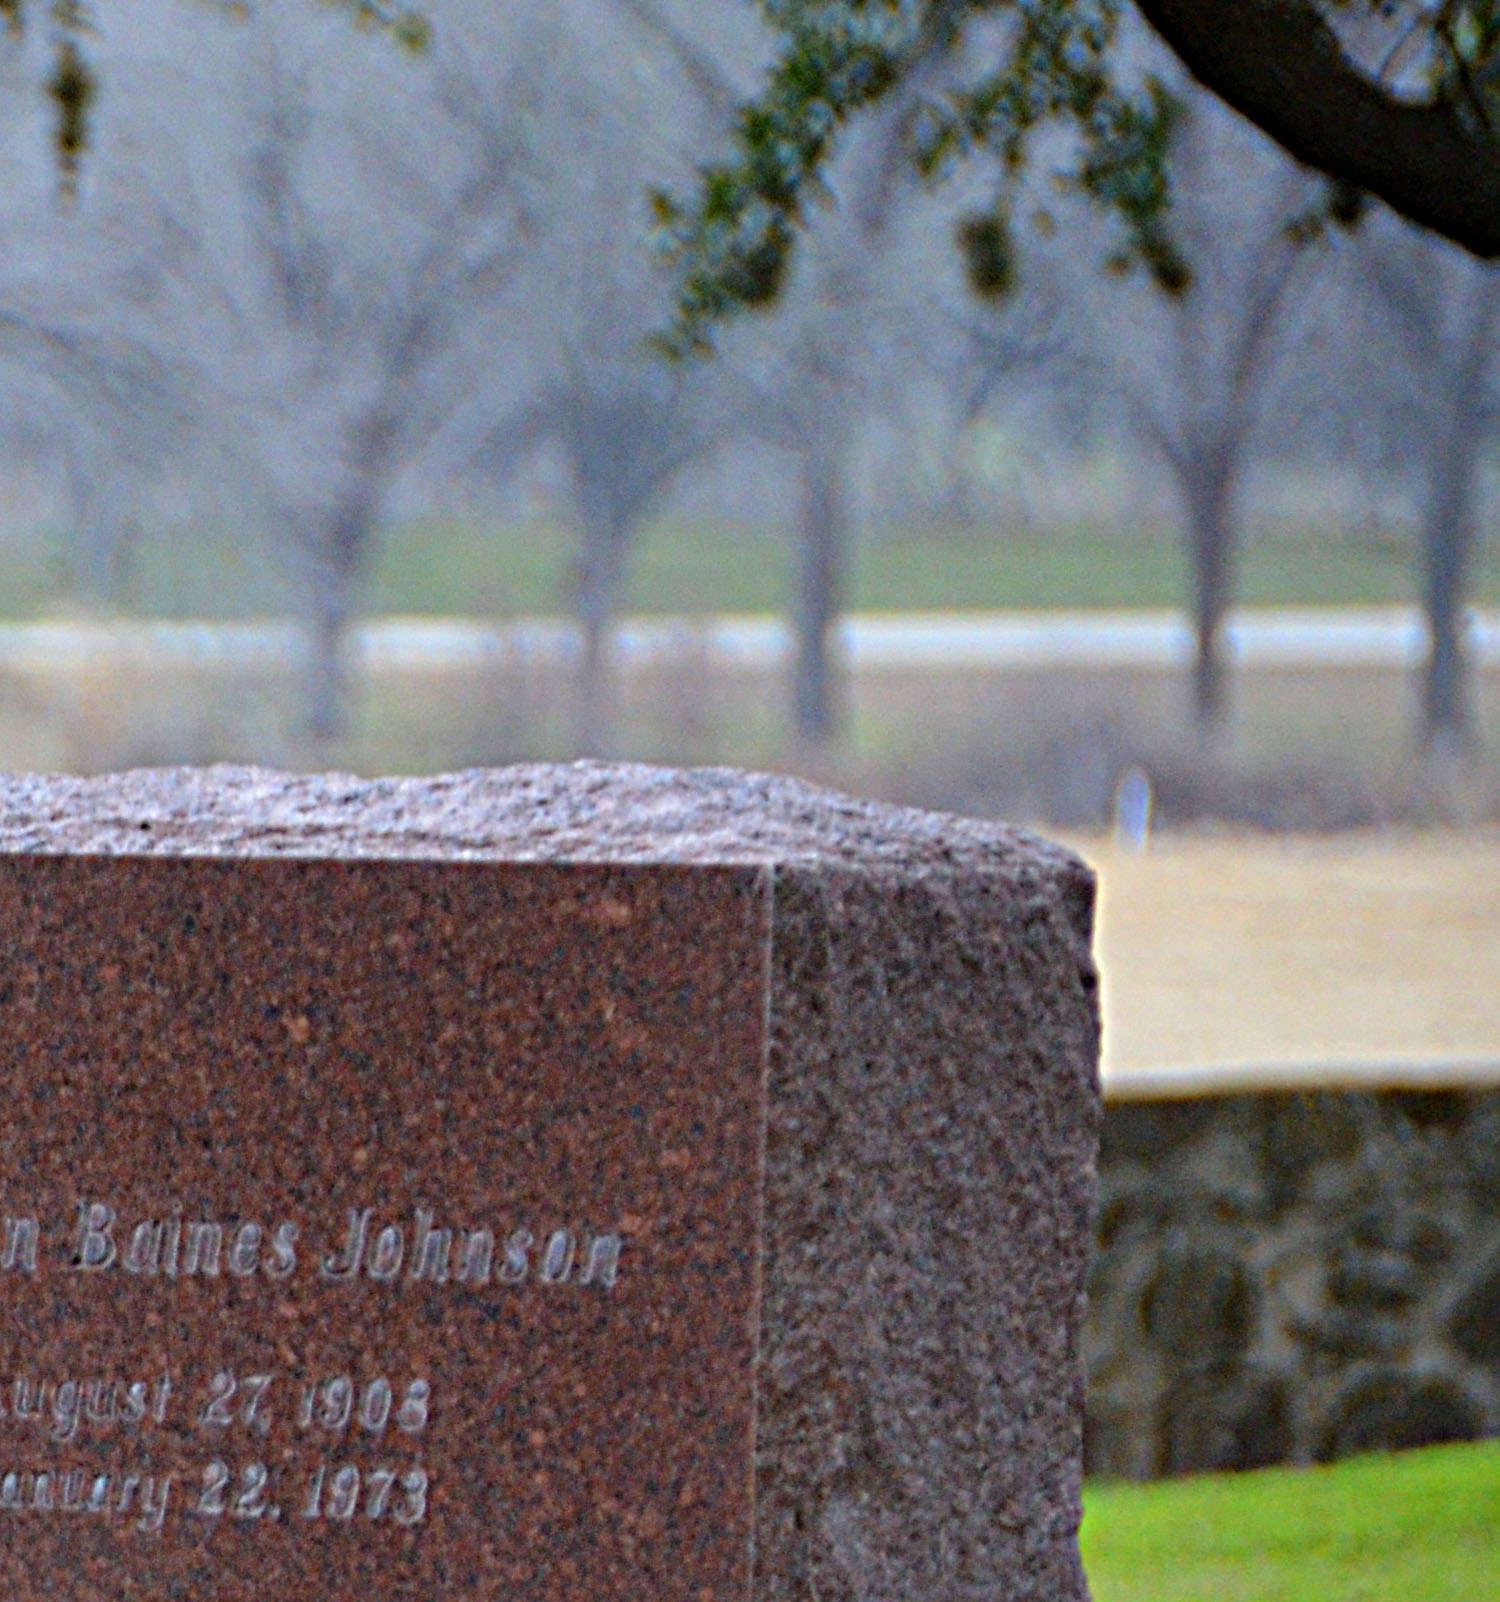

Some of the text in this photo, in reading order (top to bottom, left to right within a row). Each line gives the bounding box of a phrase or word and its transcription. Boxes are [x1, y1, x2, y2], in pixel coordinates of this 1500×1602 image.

[73, 1202, 299, 1278] Baines
[324, 1206, 624, 1288] Johnson
[299, 1374, 431, 1433] 1908
[300, 1462, 429, 1525] 1973
